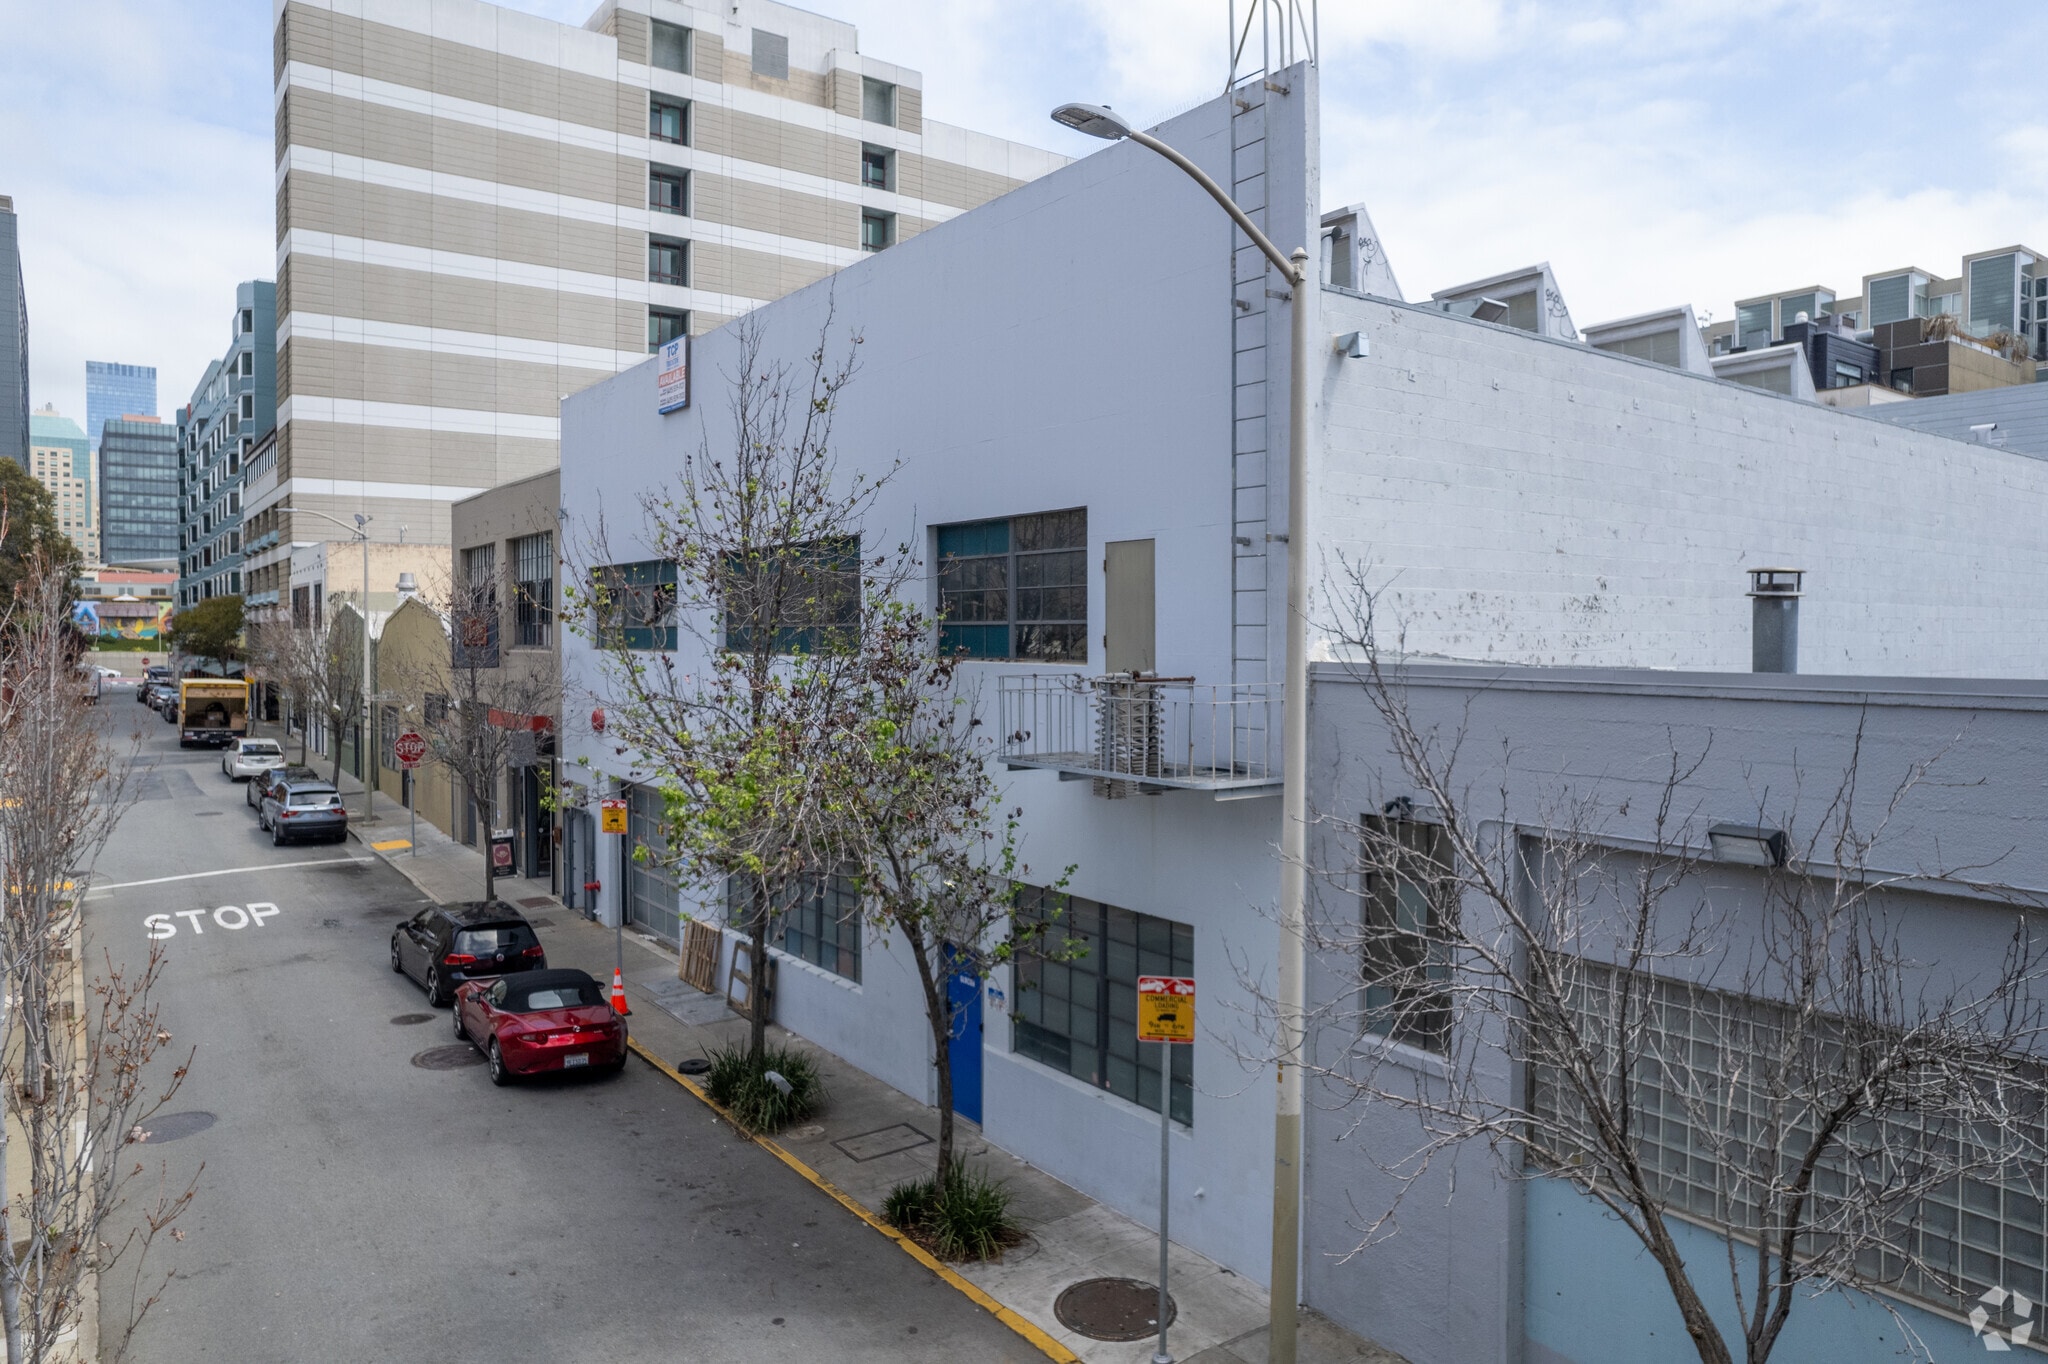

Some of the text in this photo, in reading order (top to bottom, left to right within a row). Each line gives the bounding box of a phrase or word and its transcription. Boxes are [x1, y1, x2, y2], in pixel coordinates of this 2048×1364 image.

[396, 742, 424, 754] STOP
[143, 902, 280, 939] STOP
[1146, 995, 1187, 1004] COMMERCIAL
[1155, 1001, 1179, 1009] LOADING
